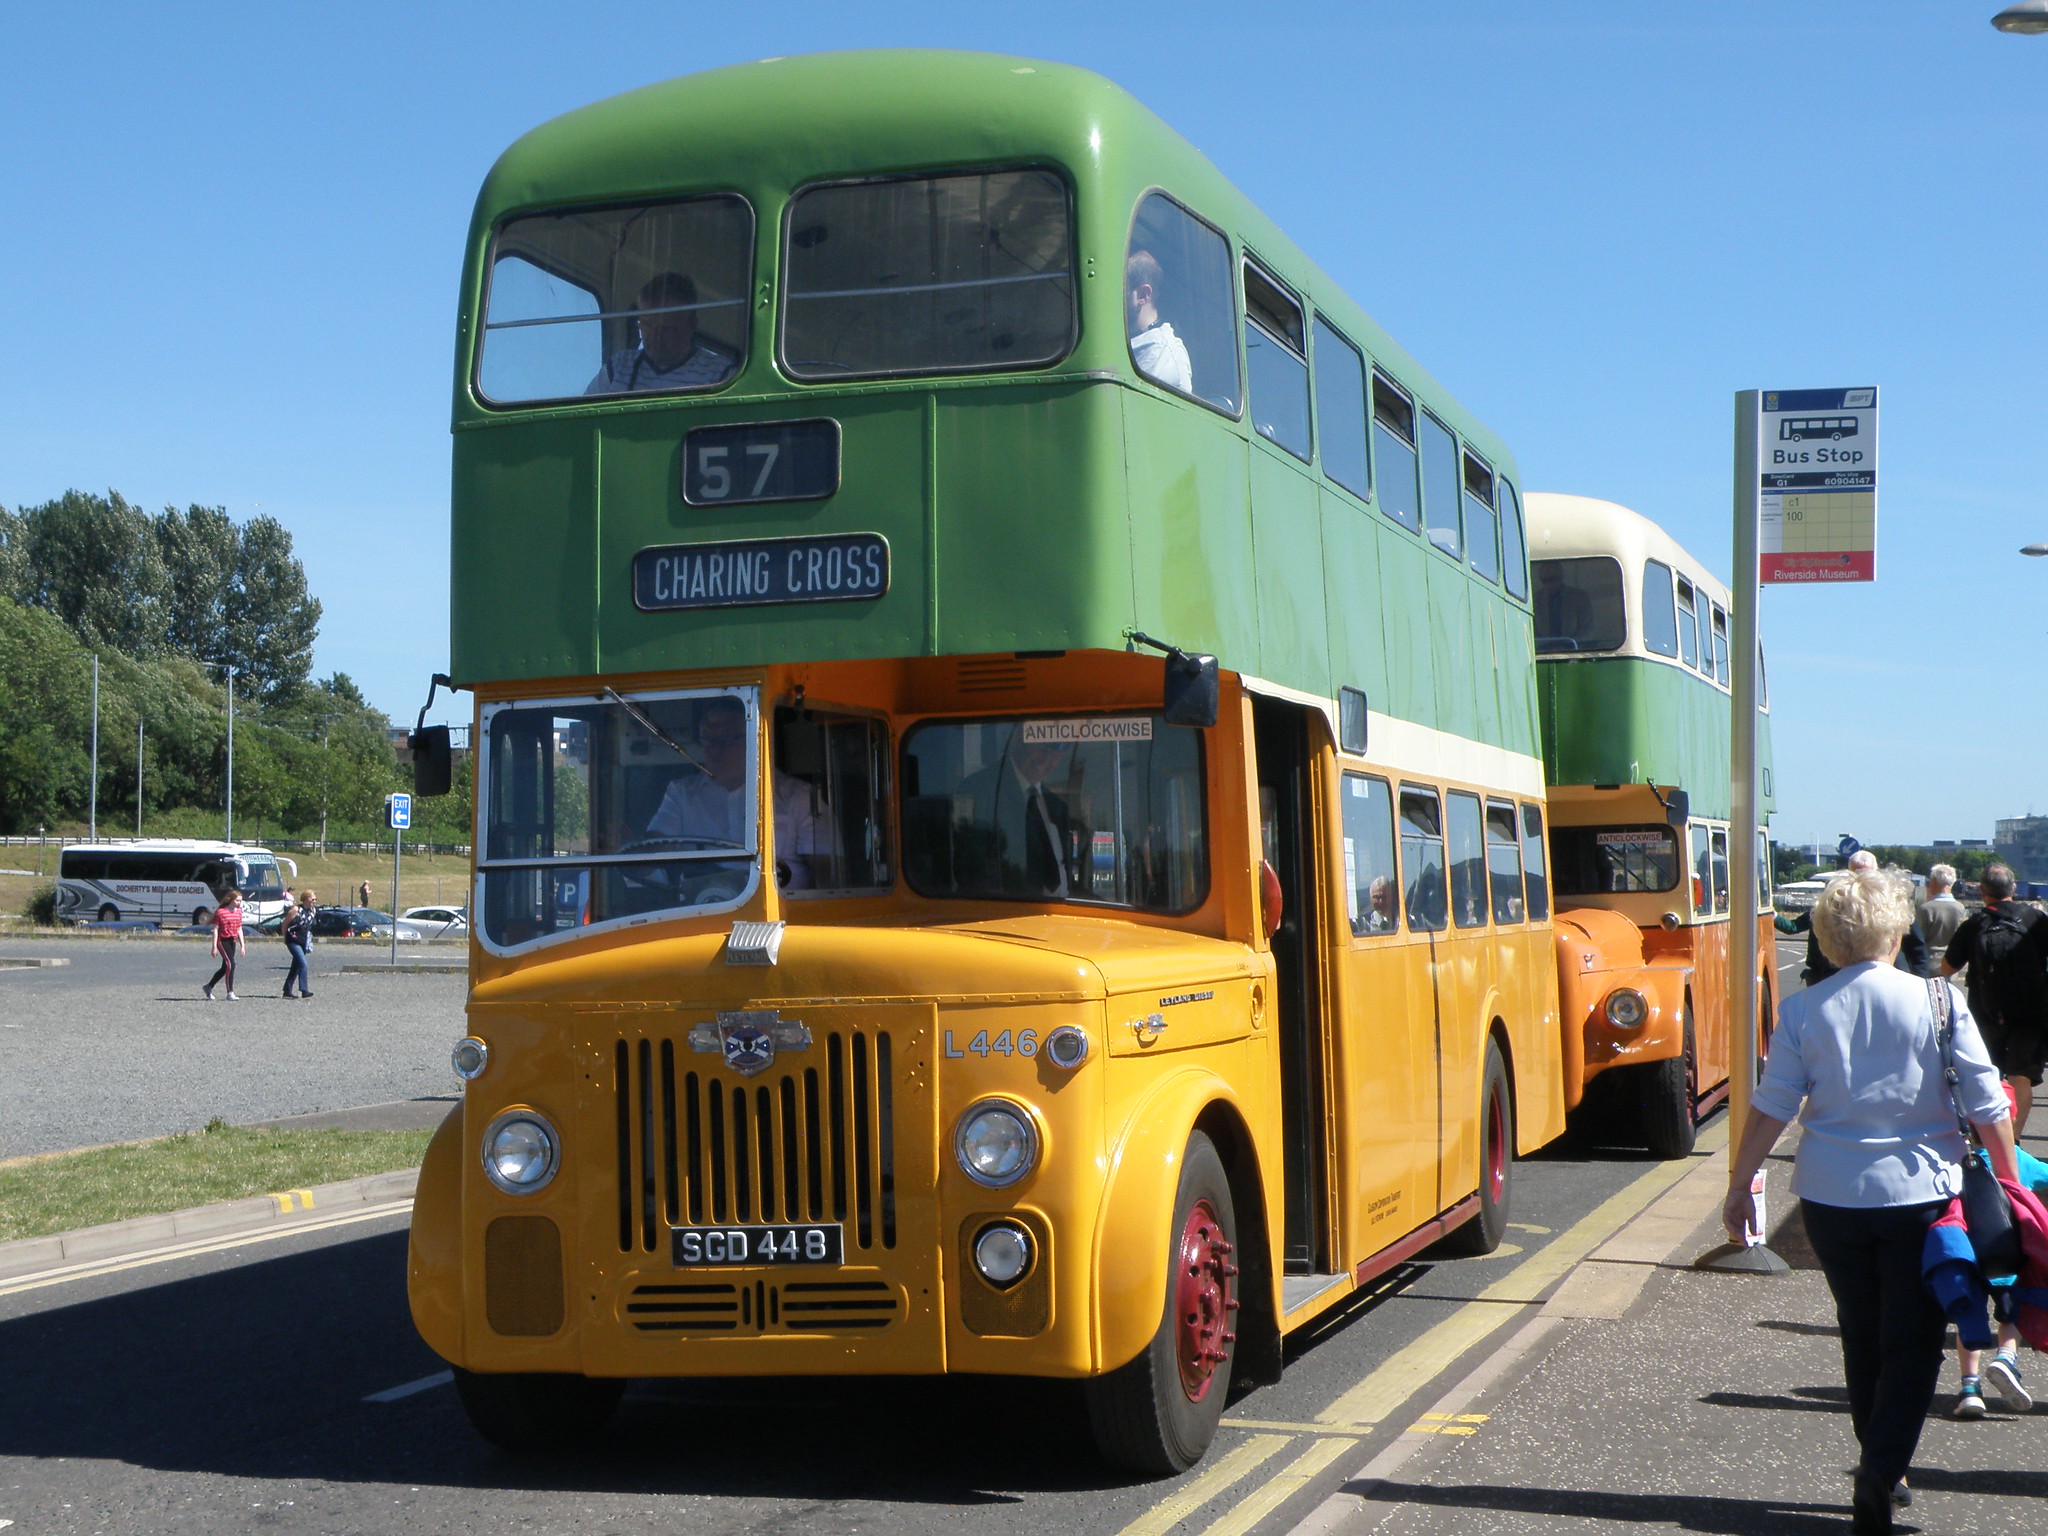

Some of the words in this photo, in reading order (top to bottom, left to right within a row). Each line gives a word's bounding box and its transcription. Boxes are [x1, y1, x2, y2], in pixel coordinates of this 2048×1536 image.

[1773, 449, 1810, 464] Bus
[1816, 447, 1863, 465] Stop
[698, 444, 779, 498] 57
[1824, 477, 1871, 486] 60904147
[1786, 511, 1803, 521] 100
[655, 552, 770, 600] CHARING
[787, 544, 881, 593] CROSS
[1774, 569, 1817, 580] Riverside
[1819, 568, 1859, 579] Museum
[1025, 722, 1150, 739] ANTICLOCKWISE
[395, 799, 408, 809] EXIT
[1597, 833, 1661, 843] ANTICLOCKWISE
[116, 884, 150, 893] DOCHERTY'S
[152, 885, 177, 894] MIDLAND
[179, 886, 205, 894] COACHES
[1161, 995, 1191, 1006] LEYLAND
[944, 1028, 1038, 1058] L446
[682, 1231, 748, 1262] SGD
[757, 1229, 826, 1261] 448
